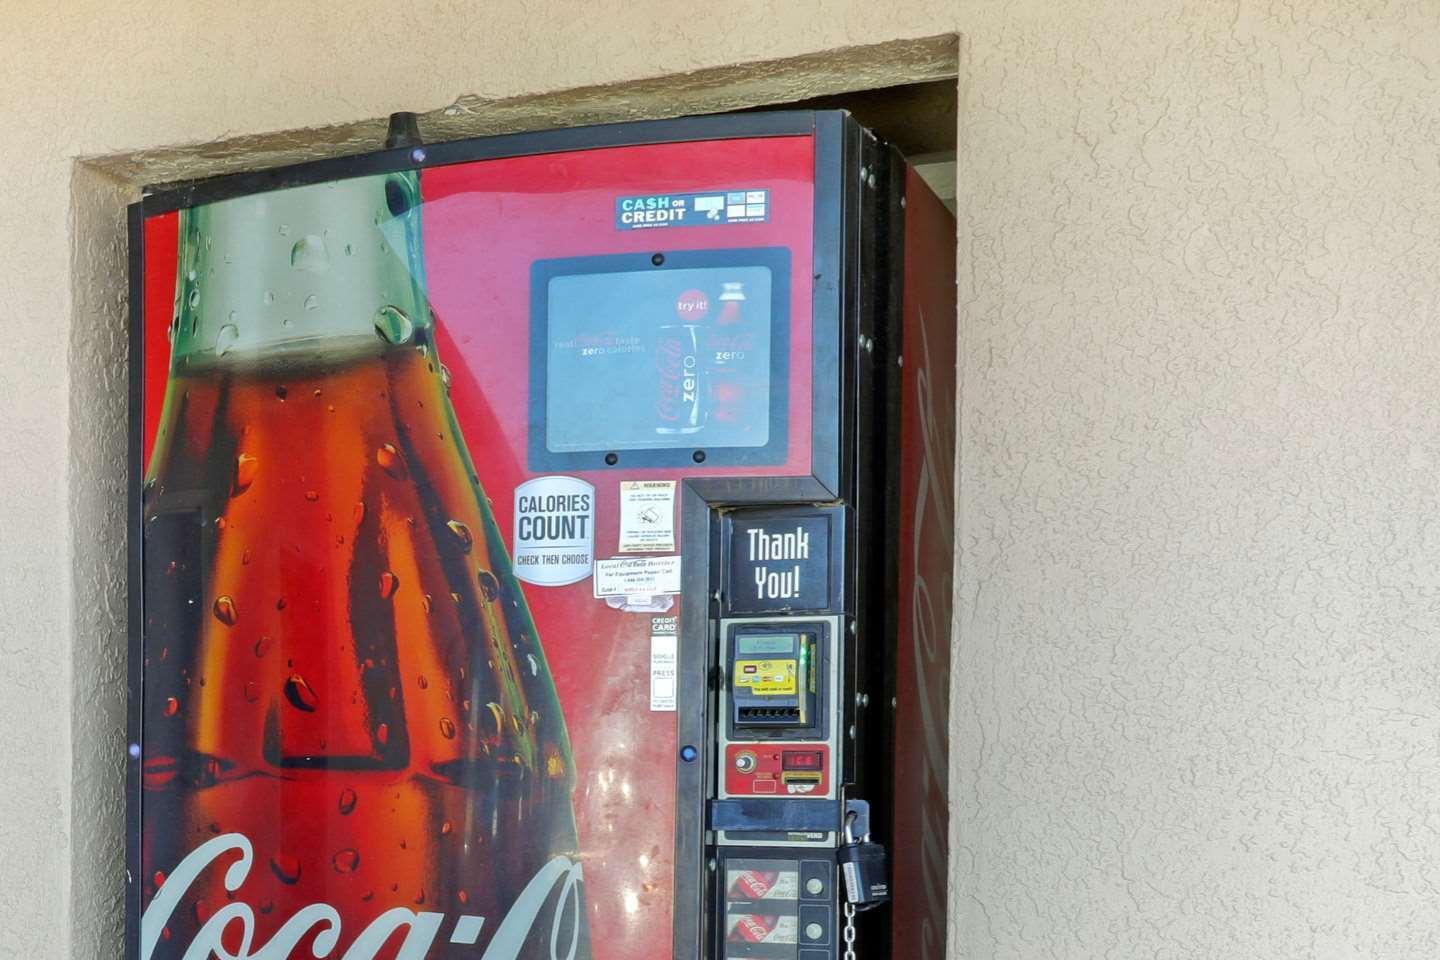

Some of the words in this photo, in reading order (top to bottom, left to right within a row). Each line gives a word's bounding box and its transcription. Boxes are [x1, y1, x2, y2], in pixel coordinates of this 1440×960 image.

[621, 208, 686, 224] CREDIT
[677, 302, 694, 312] try
[696, 301, 707, 310] it!
[715, 351, 745, 360] zero
[683, 355, 696, 402] zero
[518, 495, 591, 514] CALORIES
[518, 514, 590, 541] COUNT
[747, 527, 809, 561] Thank
[517, 554, 541, 566] CHECK
[542, 554, 560, 565] THEN
[561, 553, 589, 565] CHOOSE
[754, 565, 801, 600] You!
[652, 624, 676, 632] CARD
